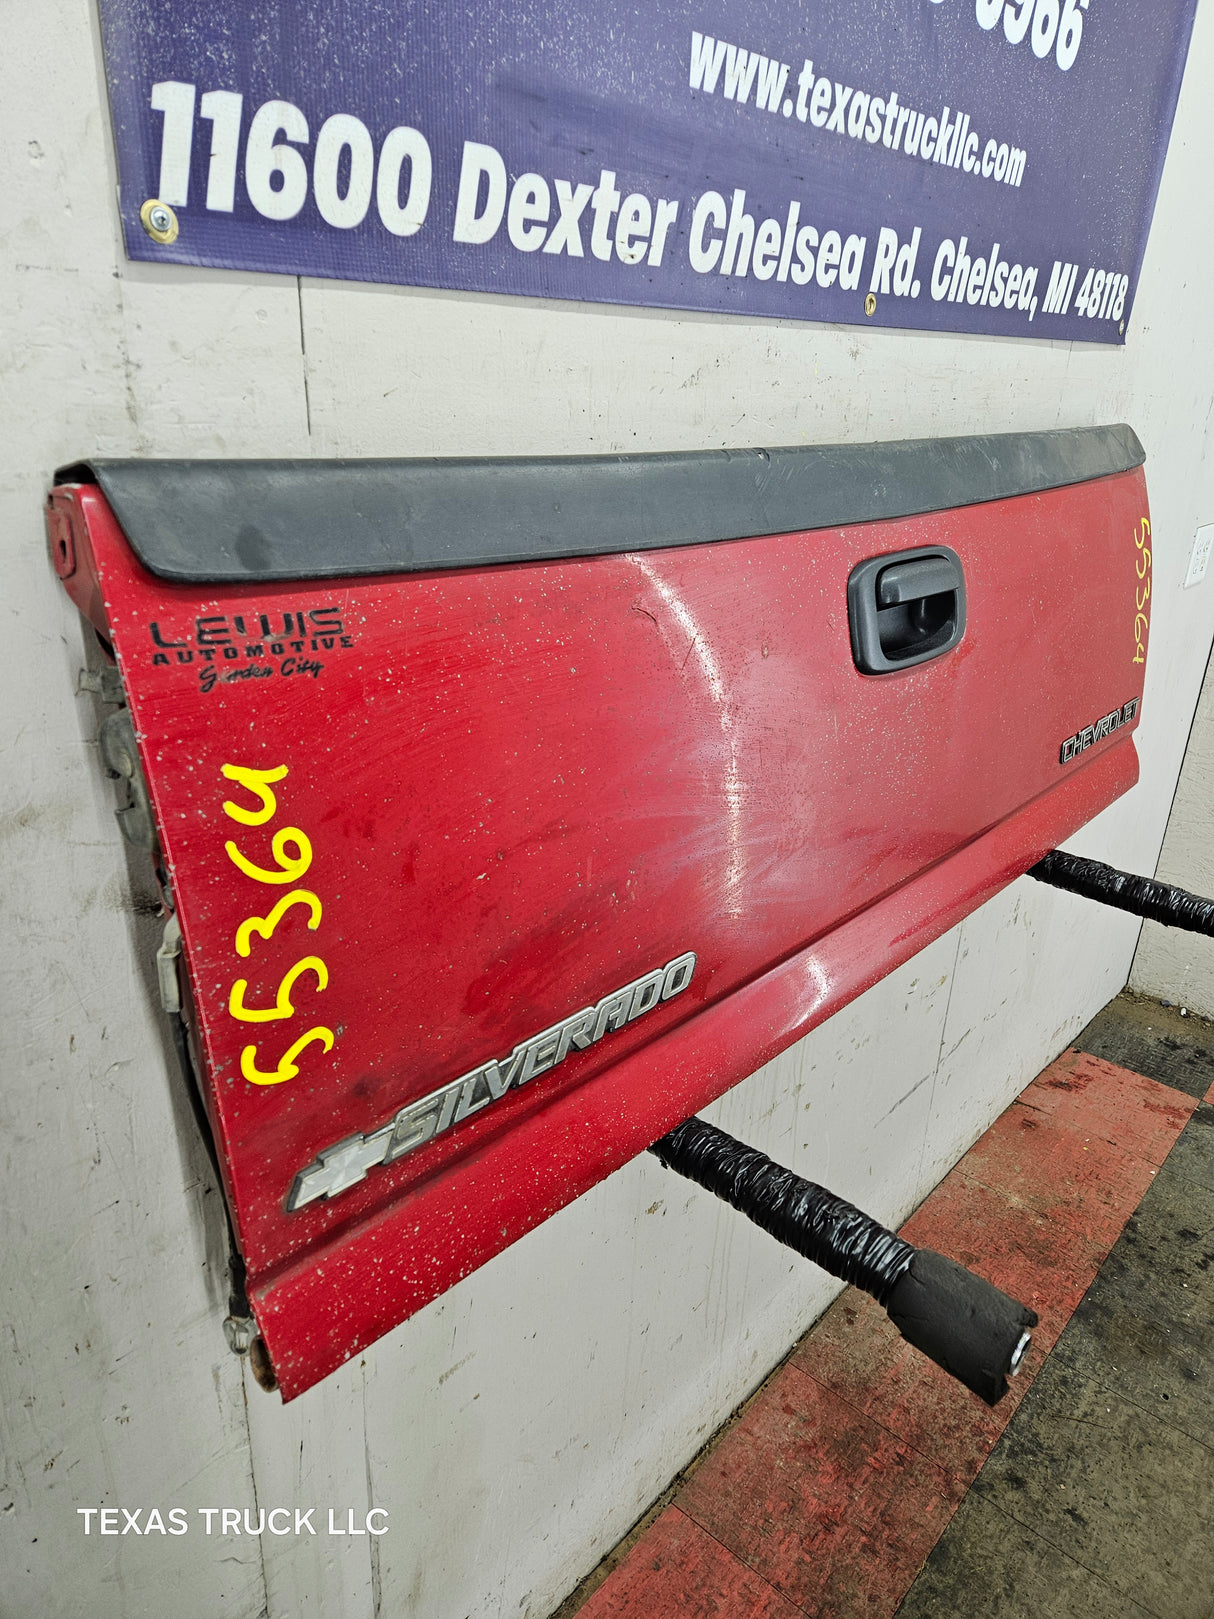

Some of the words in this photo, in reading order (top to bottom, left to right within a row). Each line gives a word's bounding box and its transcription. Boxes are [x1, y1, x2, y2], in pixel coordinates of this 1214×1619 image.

[689, 31, 1027, 187] www.texastruckllc.com
[150, 80, 432, 237] 11600
[453, 140, 680, 267] Dexter
[688, 189, 866, 291] Chelsea
[869, 227, 922, 299] Rd.
[930, 236, 1038, 322] Chelsea,
[1042, 261, 1079, 315] MI
[1074, 268, 1129, 321] 48118
[150, 607, 344, 648] LEWIS
[152, 635, 354, 666] AUTOMOTIVE
[1132, 517, 1151, 664] 55364
[280, 656, 324, 678] City
[1060, 697, 1141, 764] CHEVROLET
[221, 763, 335, 1086] 55364
[384, 950, 698, 1166] SILVERADO
